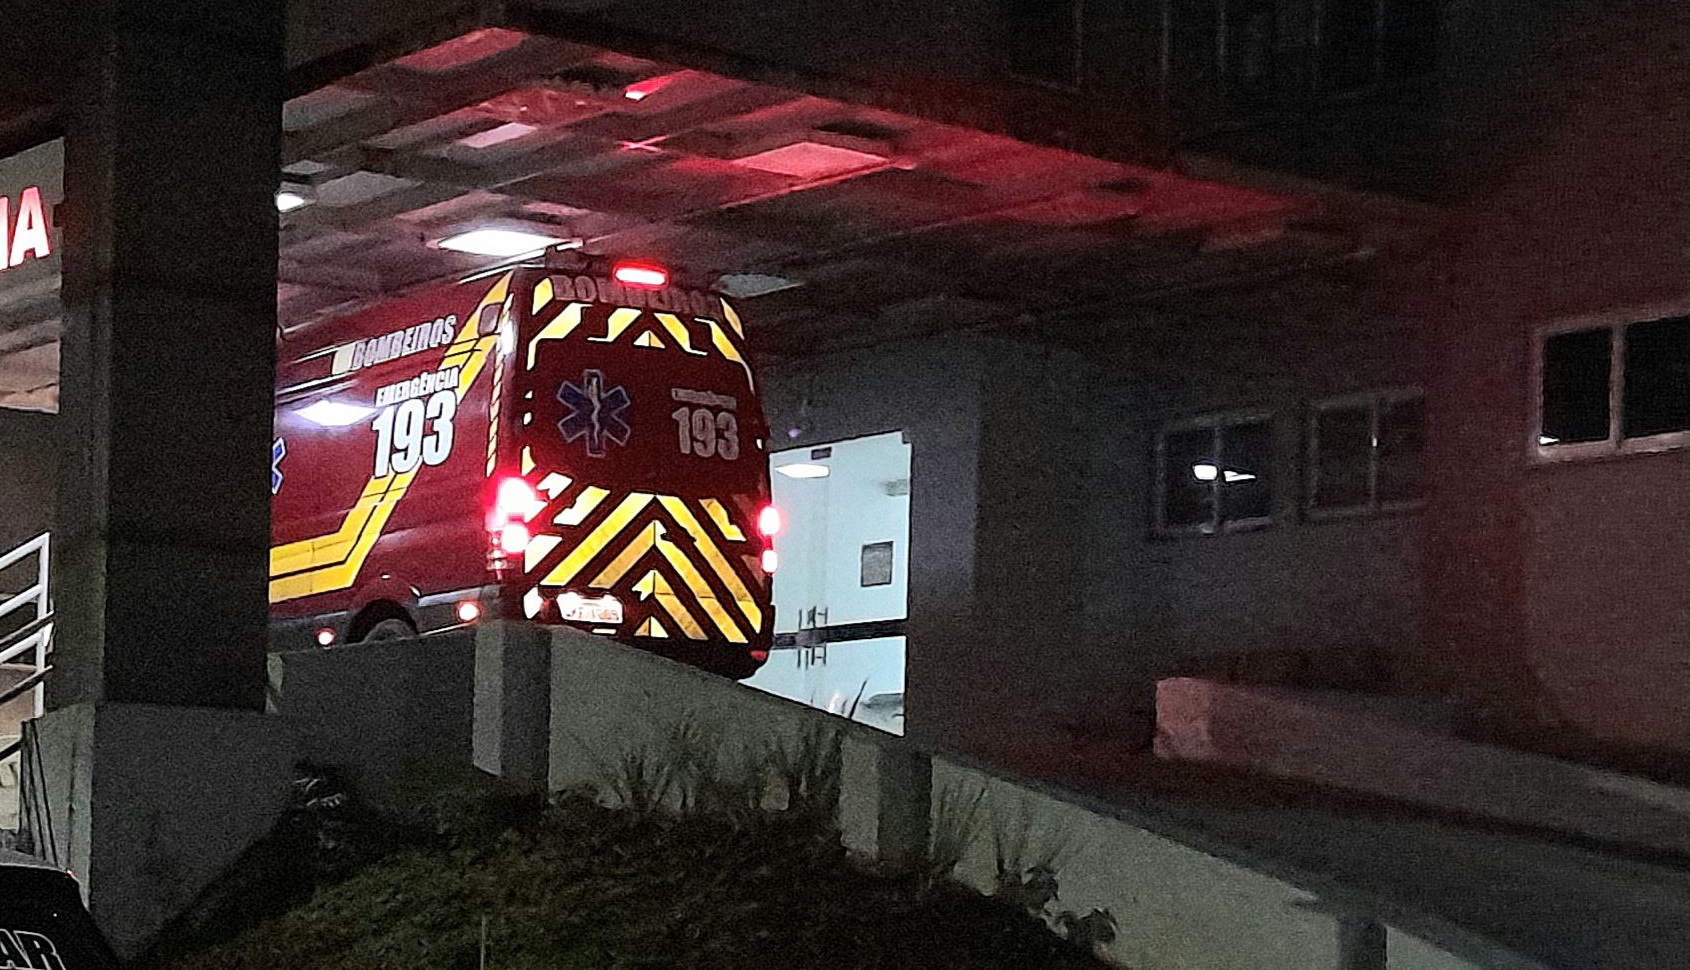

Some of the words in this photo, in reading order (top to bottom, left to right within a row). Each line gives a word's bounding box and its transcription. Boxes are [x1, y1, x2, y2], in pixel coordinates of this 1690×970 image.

[352, 315, 457, 371] BOMBEIROS
[372, 390, 458, 479] 193
[671, 406, 740, 460] 193
